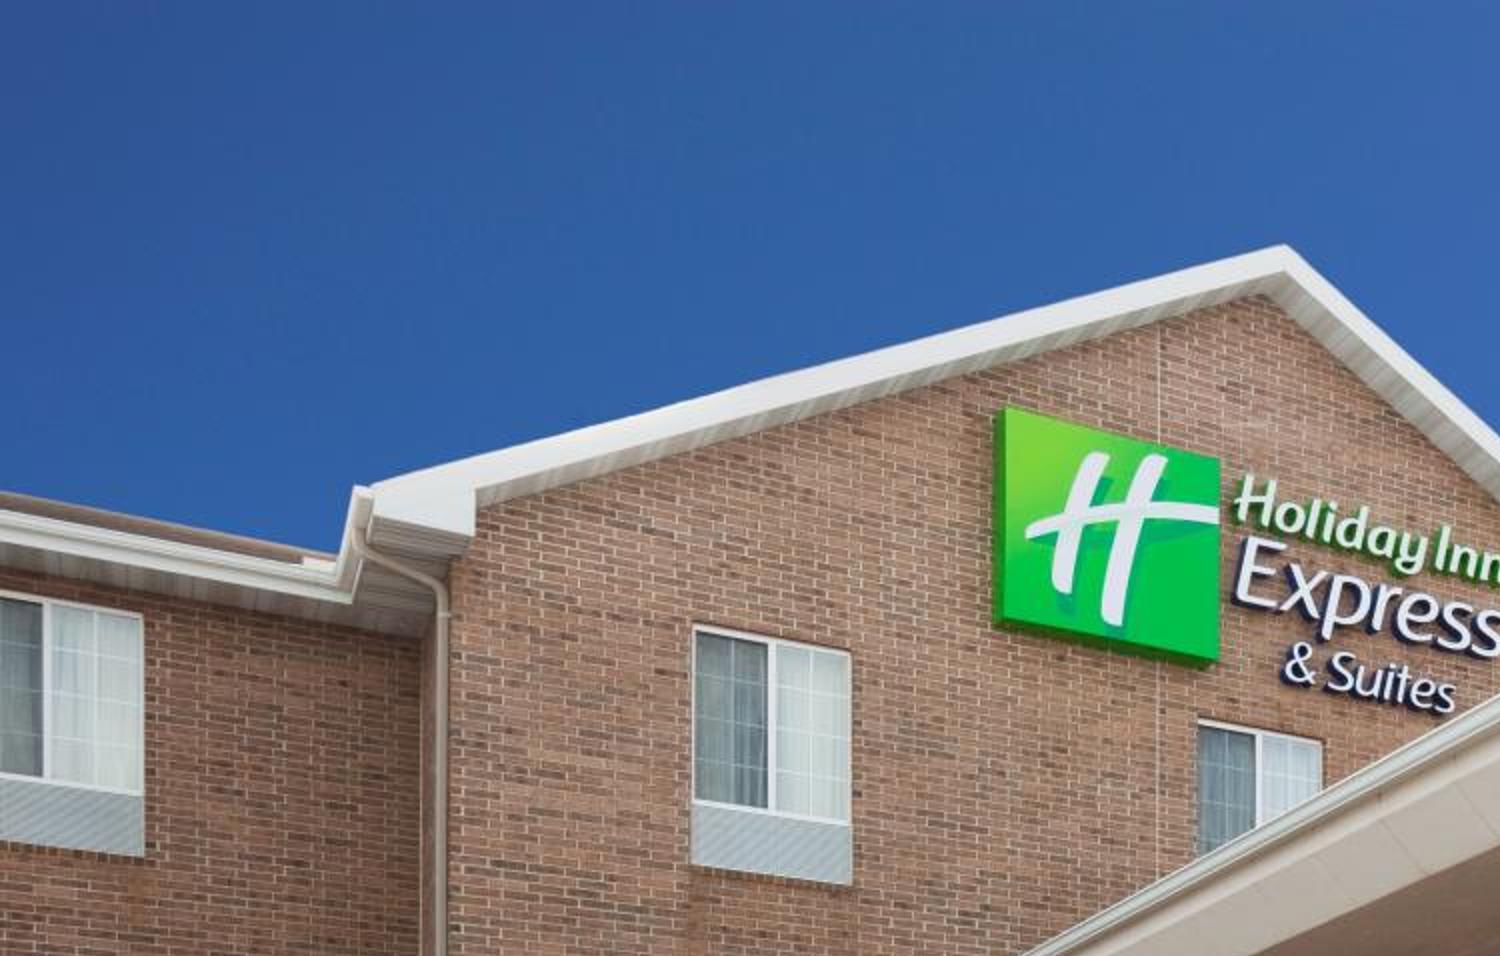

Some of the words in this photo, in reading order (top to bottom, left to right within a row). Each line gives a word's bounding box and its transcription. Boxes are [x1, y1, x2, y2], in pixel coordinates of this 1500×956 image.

[1025, 452, 1219, 626] H
[1234, 474, 1430, 575] Holiday
[1284, 641, 1316, 685] &
[1326, 650, 1457, 714] Suites
